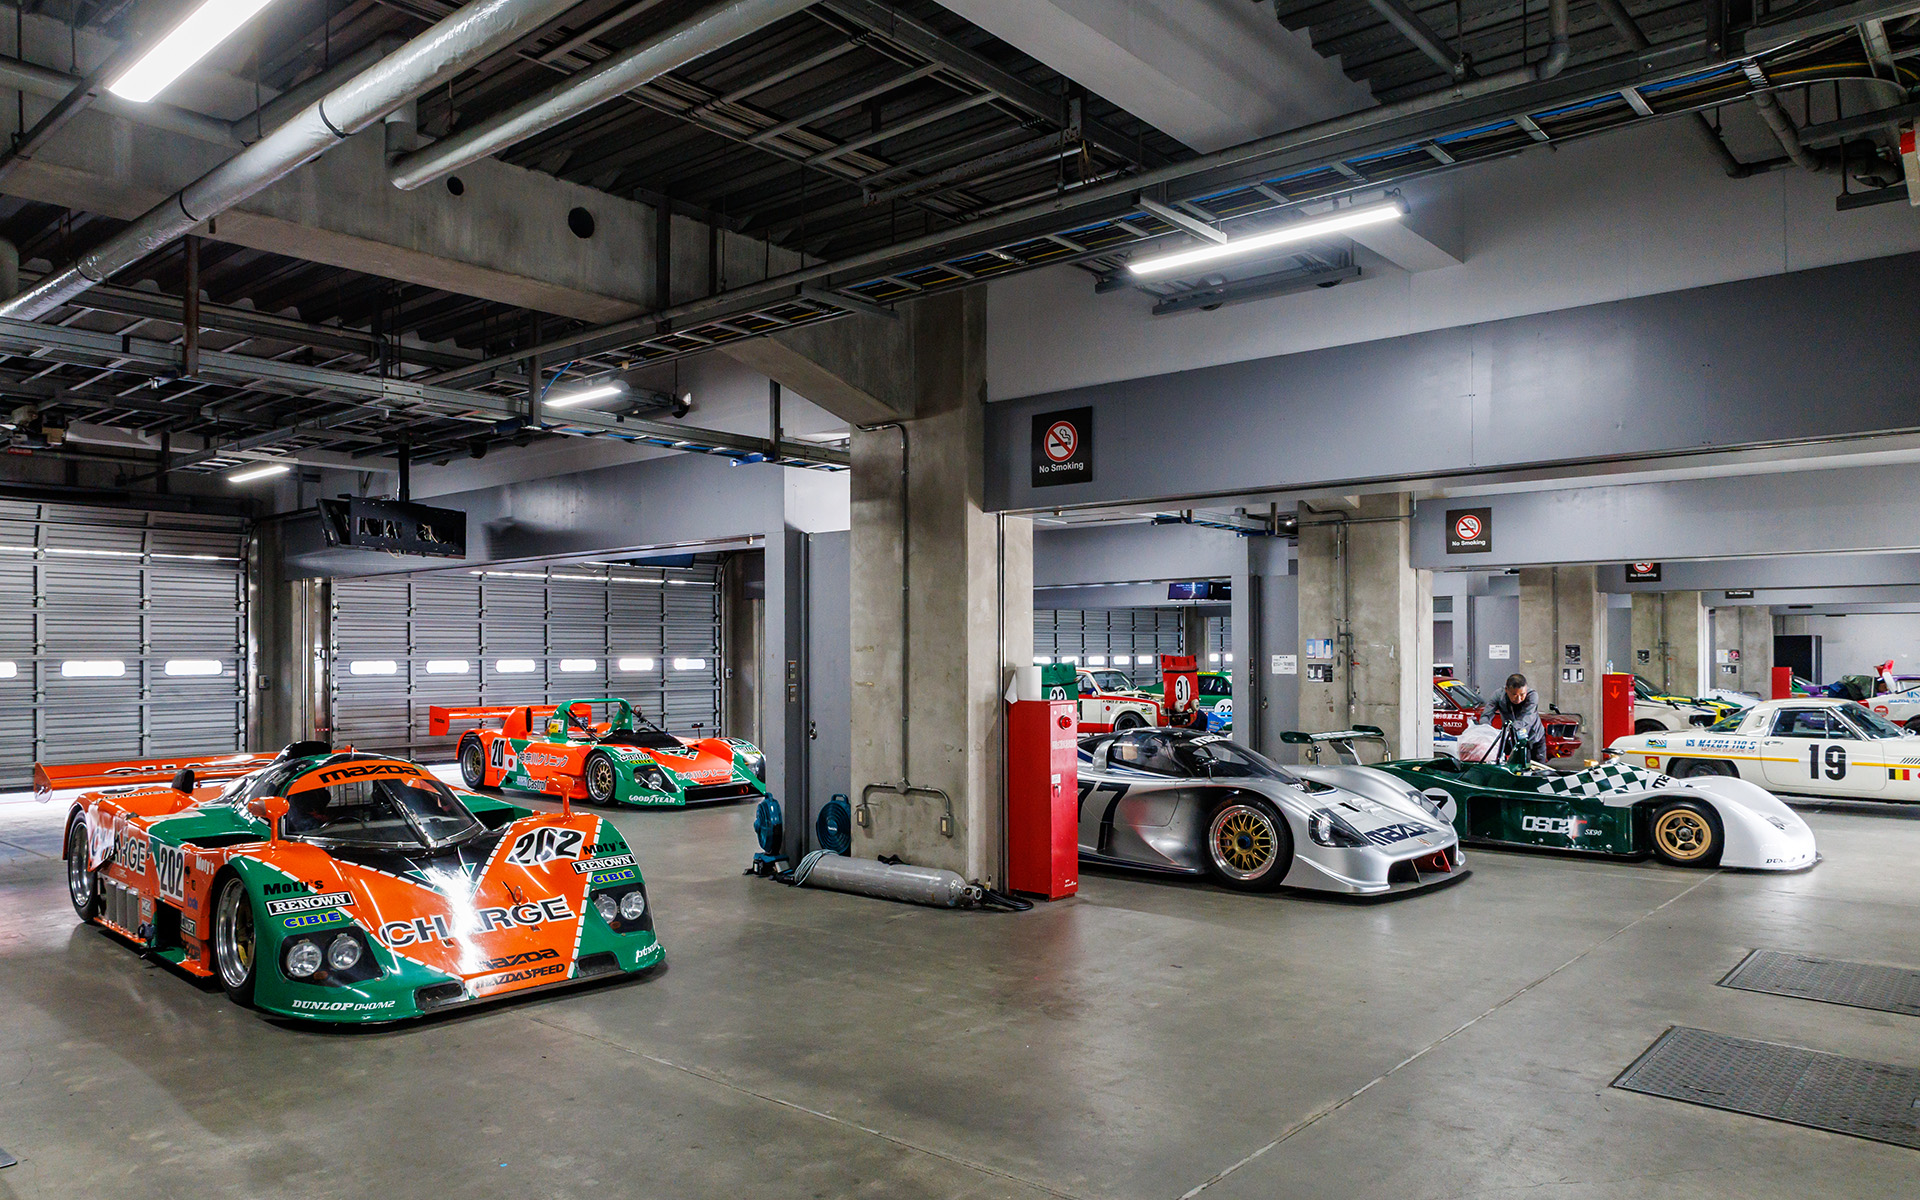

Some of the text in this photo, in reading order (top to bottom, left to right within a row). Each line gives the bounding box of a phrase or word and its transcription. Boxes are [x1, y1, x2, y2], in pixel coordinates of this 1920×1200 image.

[1039, 461, 1084, 474] No Smoking
[1176, 679, 1189, 701] 31
[491, 739, 505, 768] 20
[1809, 744, 1847, 780] 19
[318, 764, 422, 783] mazda
[526, 777, 547, 791] Castrol
[506, 827, 583, 866] 202
[583, 840, 628, 856] Moty's
[160, 846, 184, 898] 202
[576, 856, 633, 872] RENOWN
[263, 878, 324, 896] Moty's
[272, 894, 347, 914] RENOWN
[379, 894, 576, 948] CHRGE
[291, 999, 354, 1011] DUNLOP
